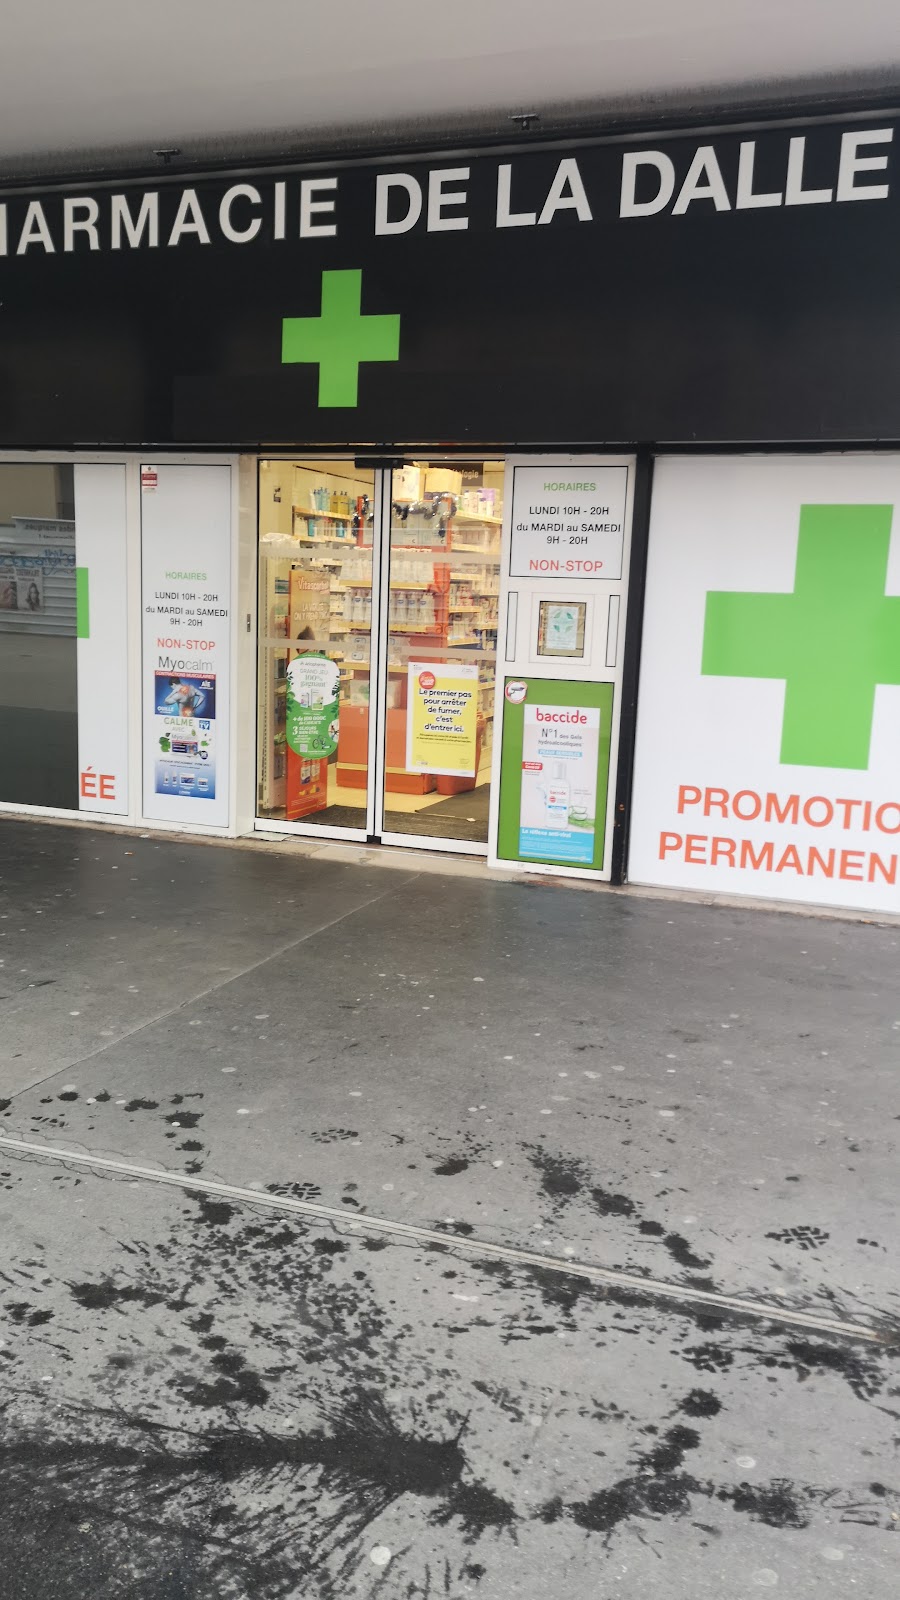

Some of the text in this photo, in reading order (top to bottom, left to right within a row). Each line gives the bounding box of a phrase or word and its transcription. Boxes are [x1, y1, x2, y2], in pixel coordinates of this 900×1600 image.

[0, 128, 893, 255] ARMACIE DE LA DALLE
[543, 482, 597, 492] HORAIRES
[529, 506, 560, 515] LUNDI
[563, 506, 581, 515] 10H
[590, 507, 610, 516] 20H
[516, 523, 529, 532] du
[531, 523, 564, 532] MARDI
[580, 523, 621, 533] SAMEDI
[546, 536, 560, 545] 9H
[569, 536, 588, 545] 20H
[529, 559, 603, 572] NON-STOP
[165, 571, 207, 581] HORAIRES
[154, 591, 180, 600] LUNDI
[181, 593, 196, 601] 10H
[203, 593, 218, 602] 20H
[157, 606, 183, 615] MARDI
[185, 608, 195, 616] au
[196, 608, 228, 617] SAMEDI
[169, 618, 181, 626] 9H
[187, 618, 203, 627] 20H
[157, 638, 216, 651] NON-STOP
[158, 655, 213, 672] Myocalm
[424, 698, 467, 707] pour arrêter
[438, 706, 462, 716] fumer,
[536, 707, 588, 725] baccide
[163, 717, 193, 727] CALME
[435, 714, 453, 723] c'est
[292, 726, 298, 735] 3
[425, 723, 464, 733] d'entrer ici.
[81, 766, 116, 800] ÉE
[677, 784, 900, 834] PROMOTIO
[658, 831, 898, 885] PERMANEN
